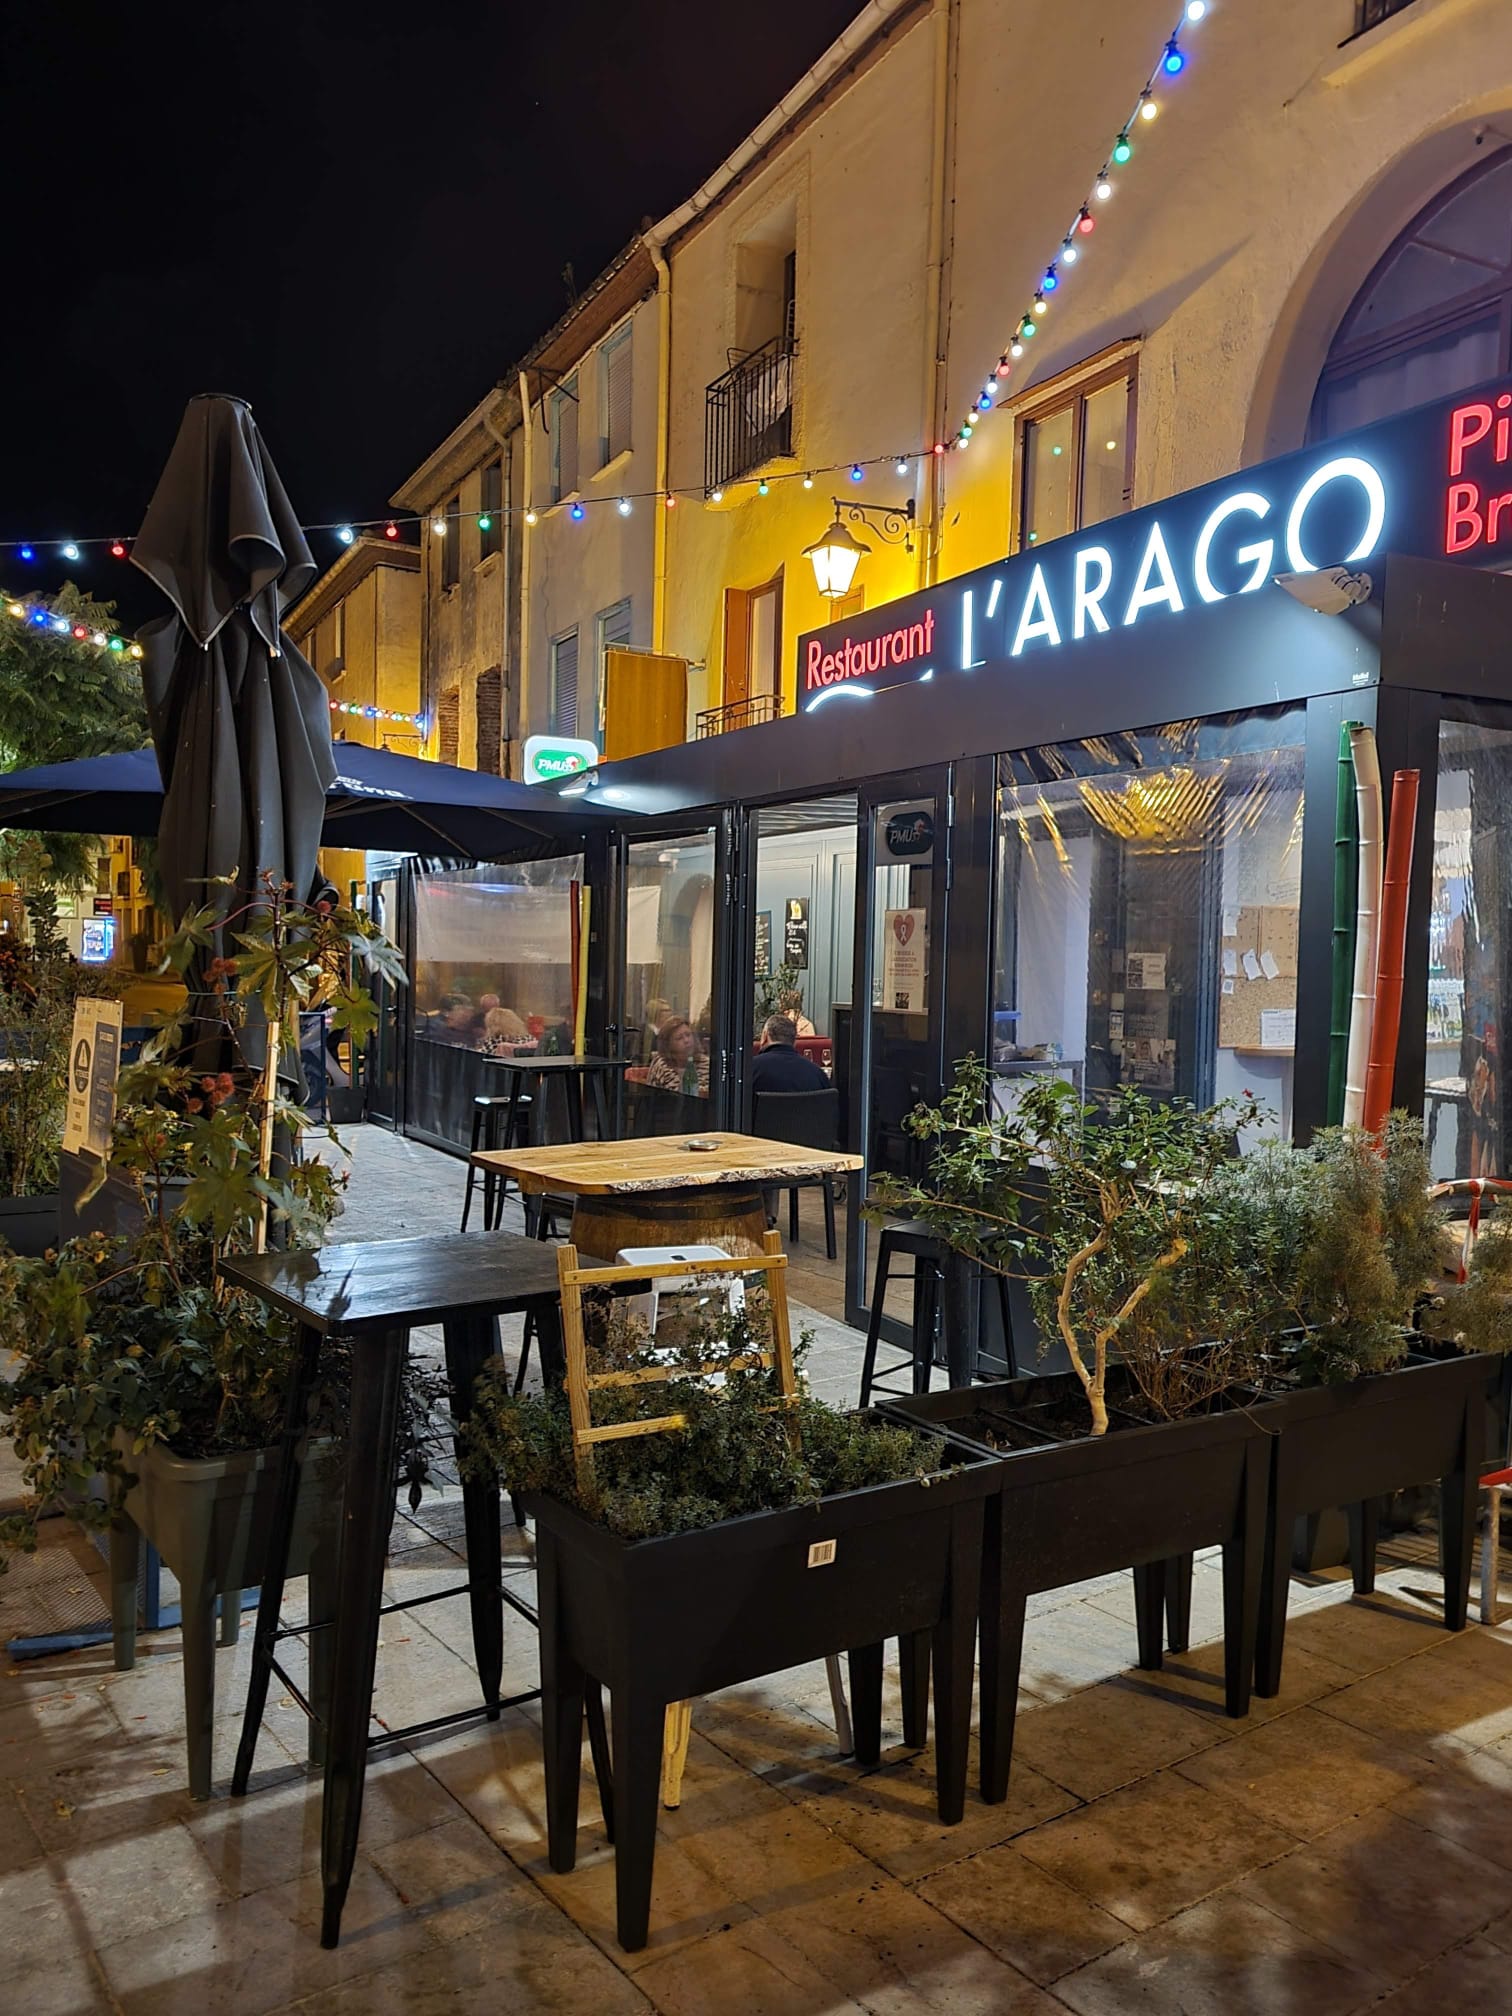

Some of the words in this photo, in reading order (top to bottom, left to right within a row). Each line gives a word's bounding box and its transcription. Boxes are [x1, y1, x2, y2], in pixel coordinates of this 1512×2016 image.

[807, 609, 935, 690] Restaurant
[961, 457, 1386, 669] L'ARAGO
[890, 829, 913, 844] PMU
